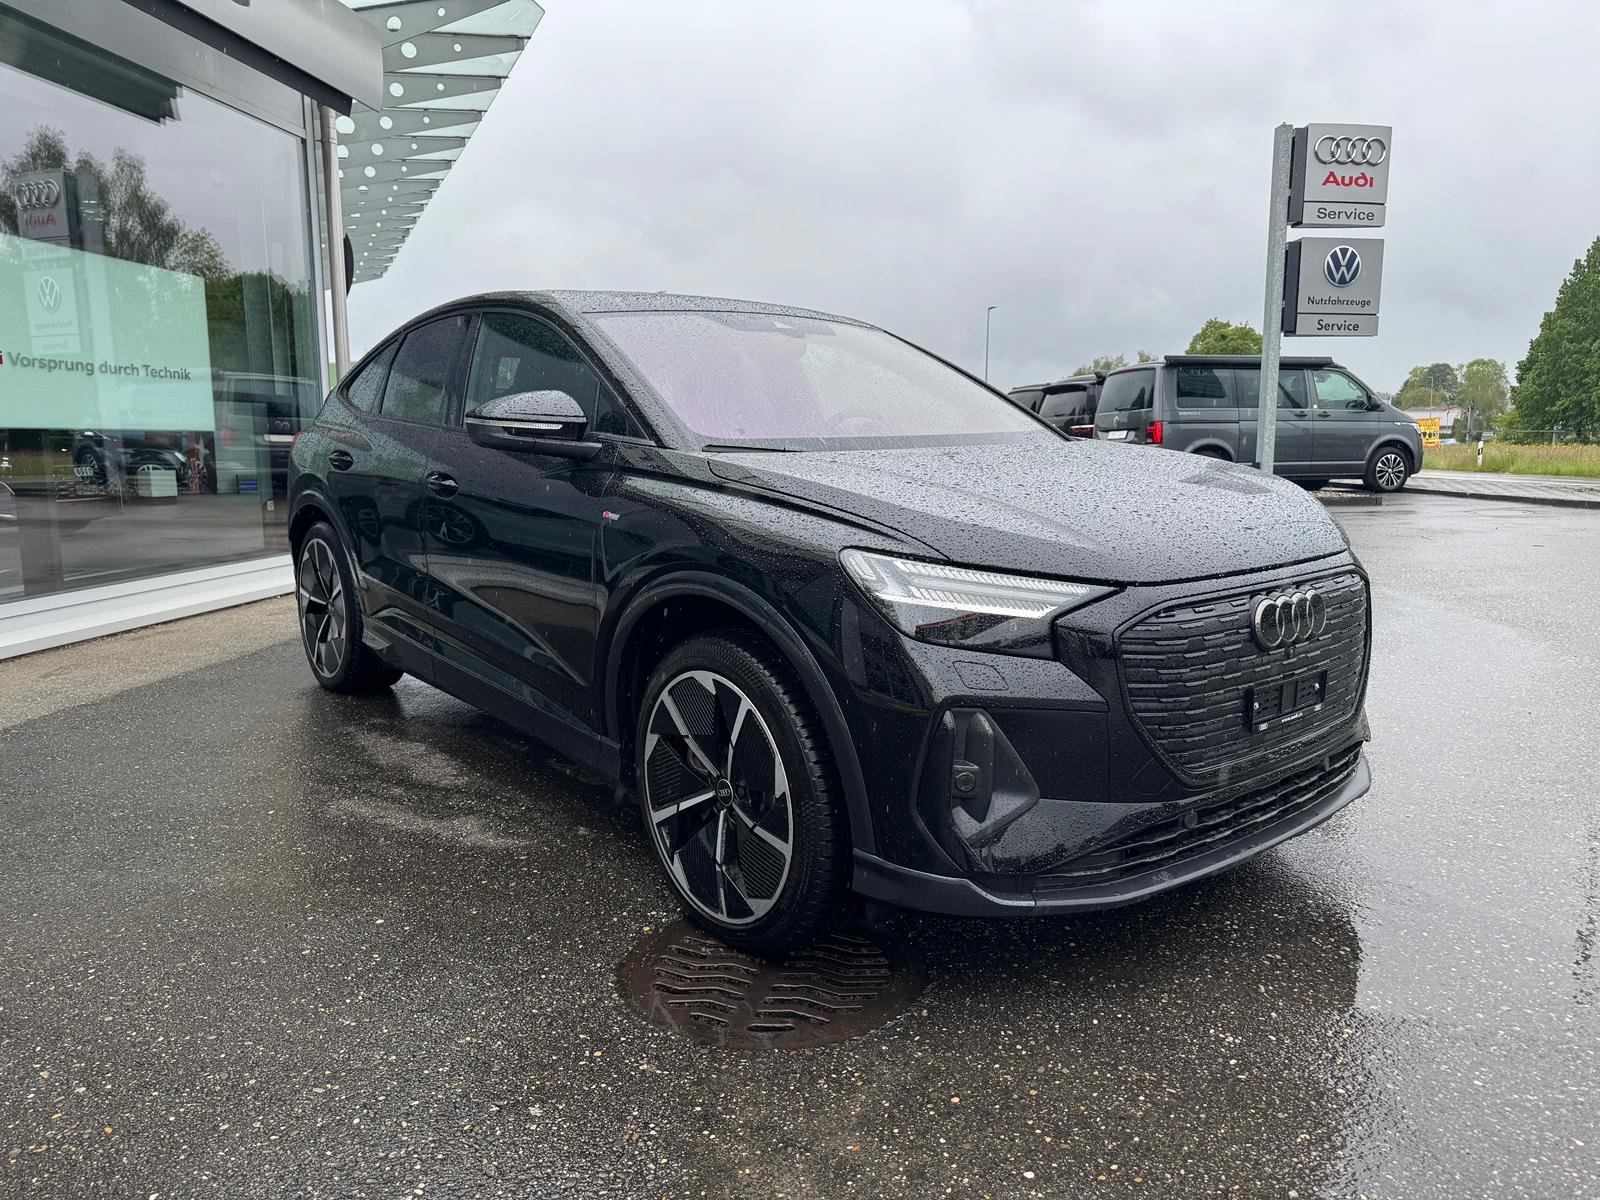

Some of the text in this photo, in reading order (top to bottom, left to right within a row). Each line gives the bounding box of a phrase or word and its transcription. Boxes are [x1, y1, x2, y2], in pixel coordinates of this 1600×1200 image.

[1322, 171, 1374, 188] Audi
[1317, 207, 1375, 221] Service
[1307, 296, 1371, 308] Nutzfahrzeuge
[1316, 319, 1360, 332] Service
[8, 352, 95, 375] Vorsprung
[99, 362, 140, 377] durch
[143, 365, 191, 381] Technik
